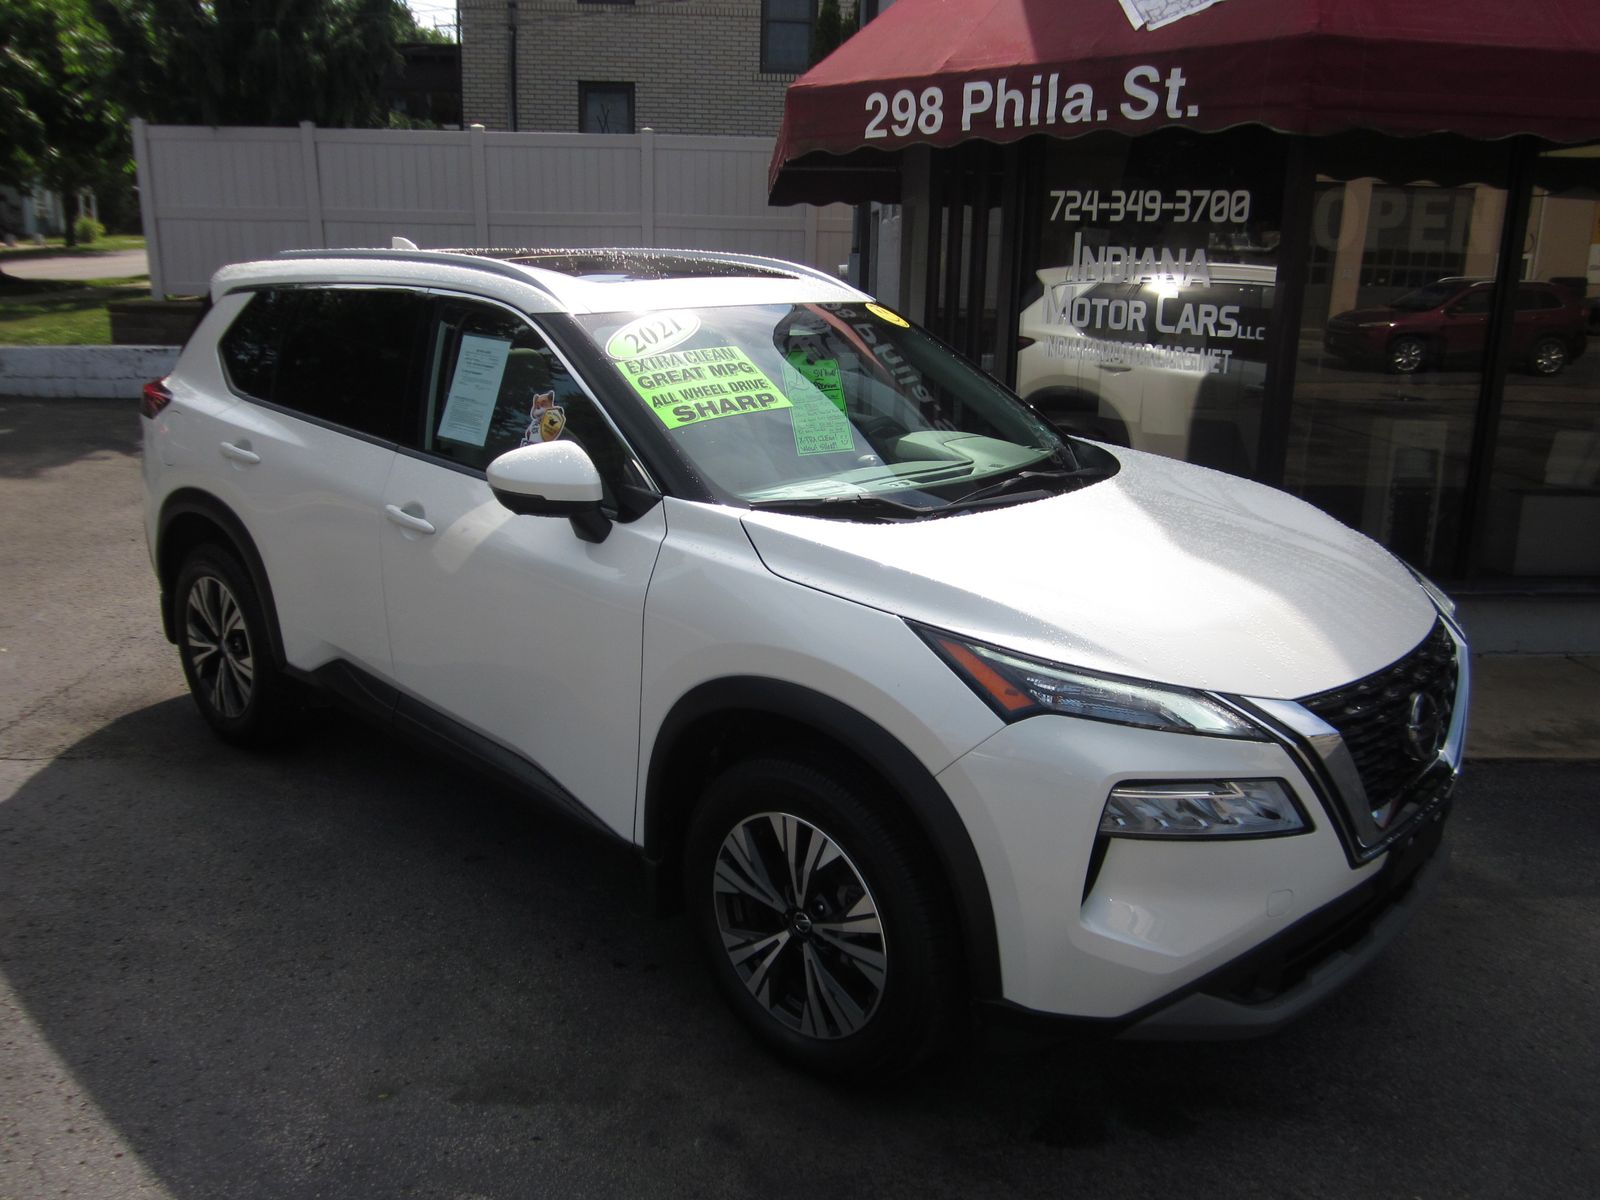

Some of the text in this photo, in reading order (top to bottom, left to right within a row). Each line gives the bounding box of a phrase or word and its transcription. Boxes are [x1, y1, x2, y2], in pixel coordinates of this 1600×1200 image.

[864, 65, 1200, 140] 298 Phila. St.
[1049, 189, 1251, 223] 724-349-3700
[624, 315, 686, 354] 2021
[1238, 326, 1265, 340] LLC
[625, 347, 738, 376] EXTRA CLEAN
[637, 362, 756, 390] GREAT MPG
[651, 378, 770, 408] ALL WHEEL DRIVE
[672, 392, 778, 423] SHARP
